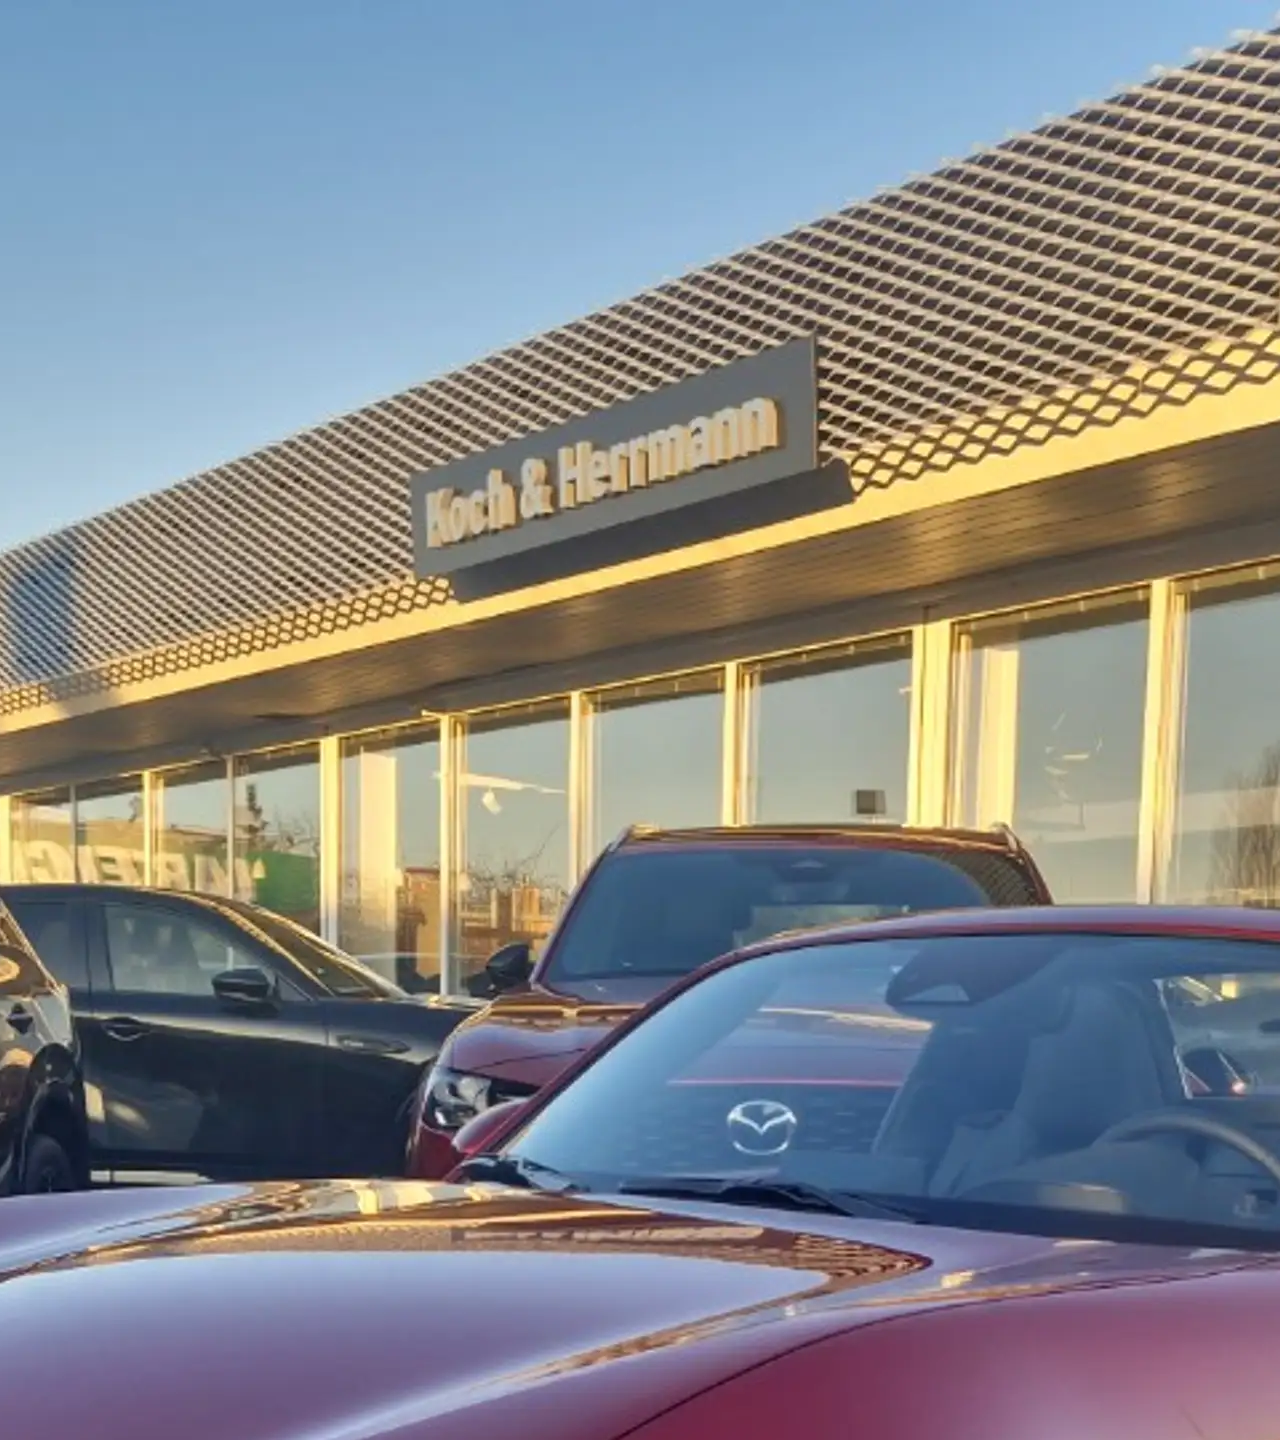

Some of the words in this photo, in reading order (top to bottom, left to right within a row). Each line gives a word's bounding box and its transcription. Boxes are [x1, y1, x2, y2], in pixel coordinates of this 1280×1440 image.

[426, 469, 517, 548] Koch
[520, 458, 555, 519] &
[558, 397, 780, 508] Herrmann
